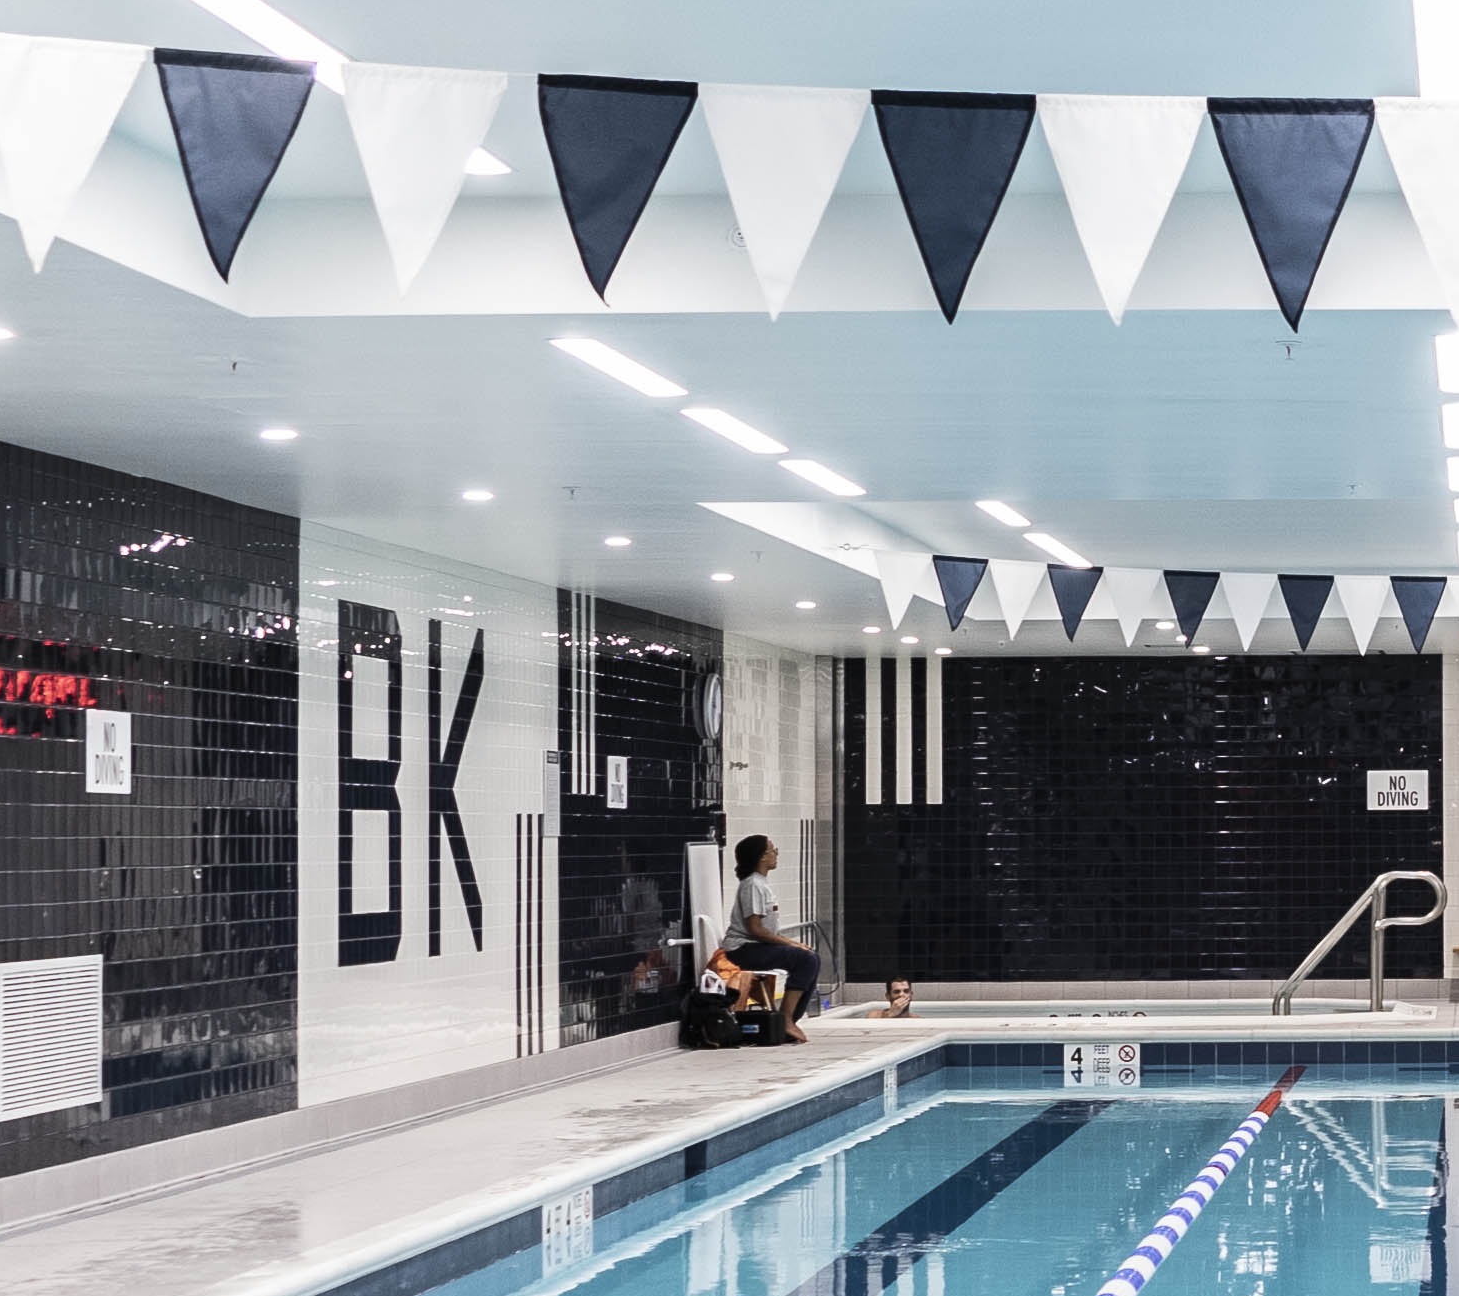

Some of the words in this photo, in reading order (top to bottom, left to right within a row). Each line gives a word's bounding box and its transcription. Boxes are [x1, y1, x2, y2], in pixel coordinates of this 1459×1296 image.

[103, 722, 116, 753] NO
[94, 753, 124, 786] DIVING
[1389, 775, 1406, 791] NO
[1377, 791, 1419, 807] DIVING
[1070, 1046, 1083, 1064] 4
